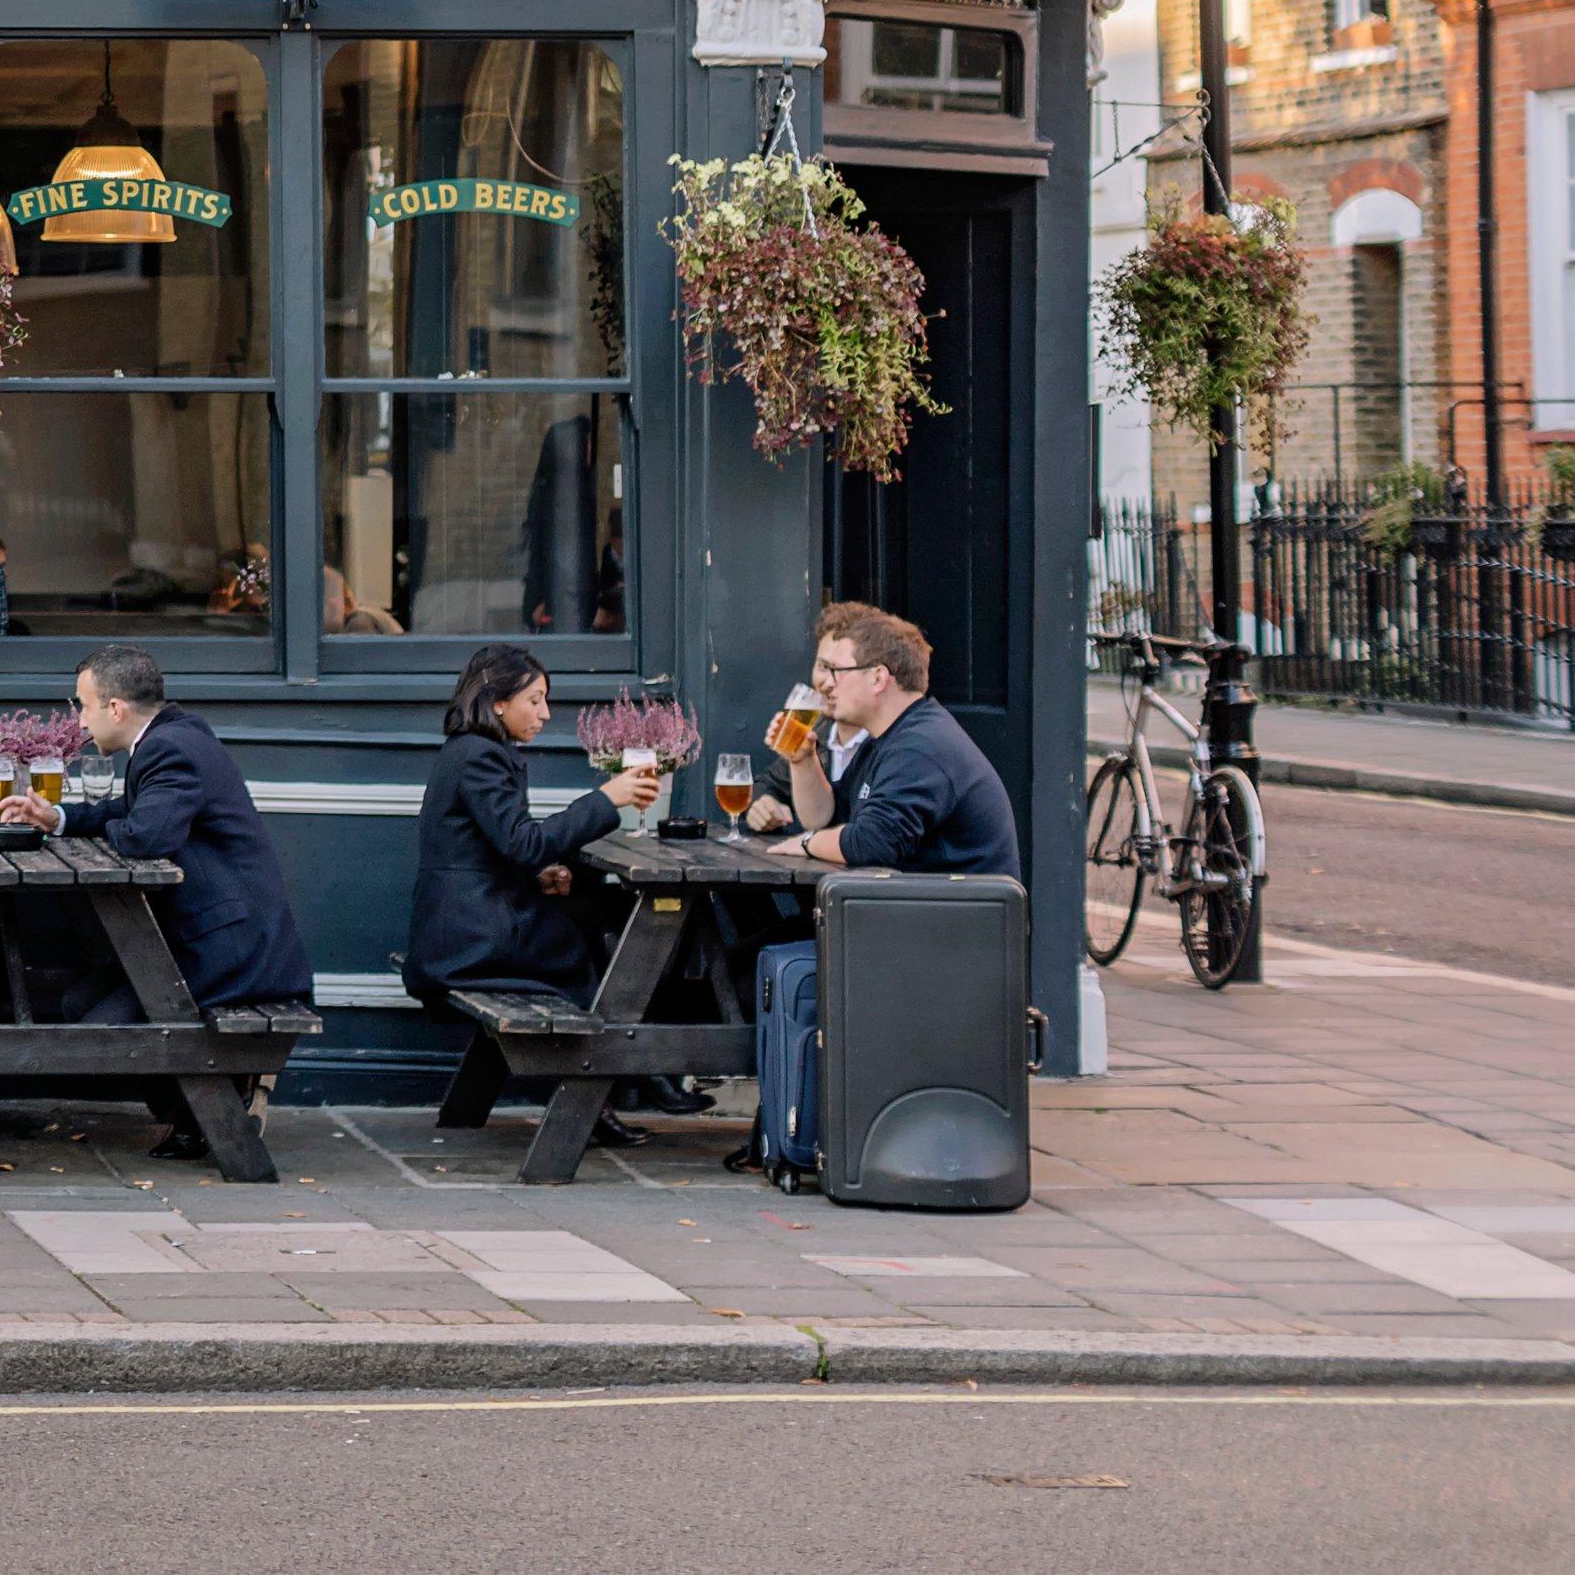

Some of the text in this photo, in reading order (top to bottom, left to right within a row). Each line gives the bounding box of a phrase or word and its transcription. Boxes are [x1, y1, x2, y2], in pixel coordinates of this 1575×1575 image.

[18, 181, 219, 220] FINE SPIRITS
[382, 182, 567, 220] COLD BEERS
